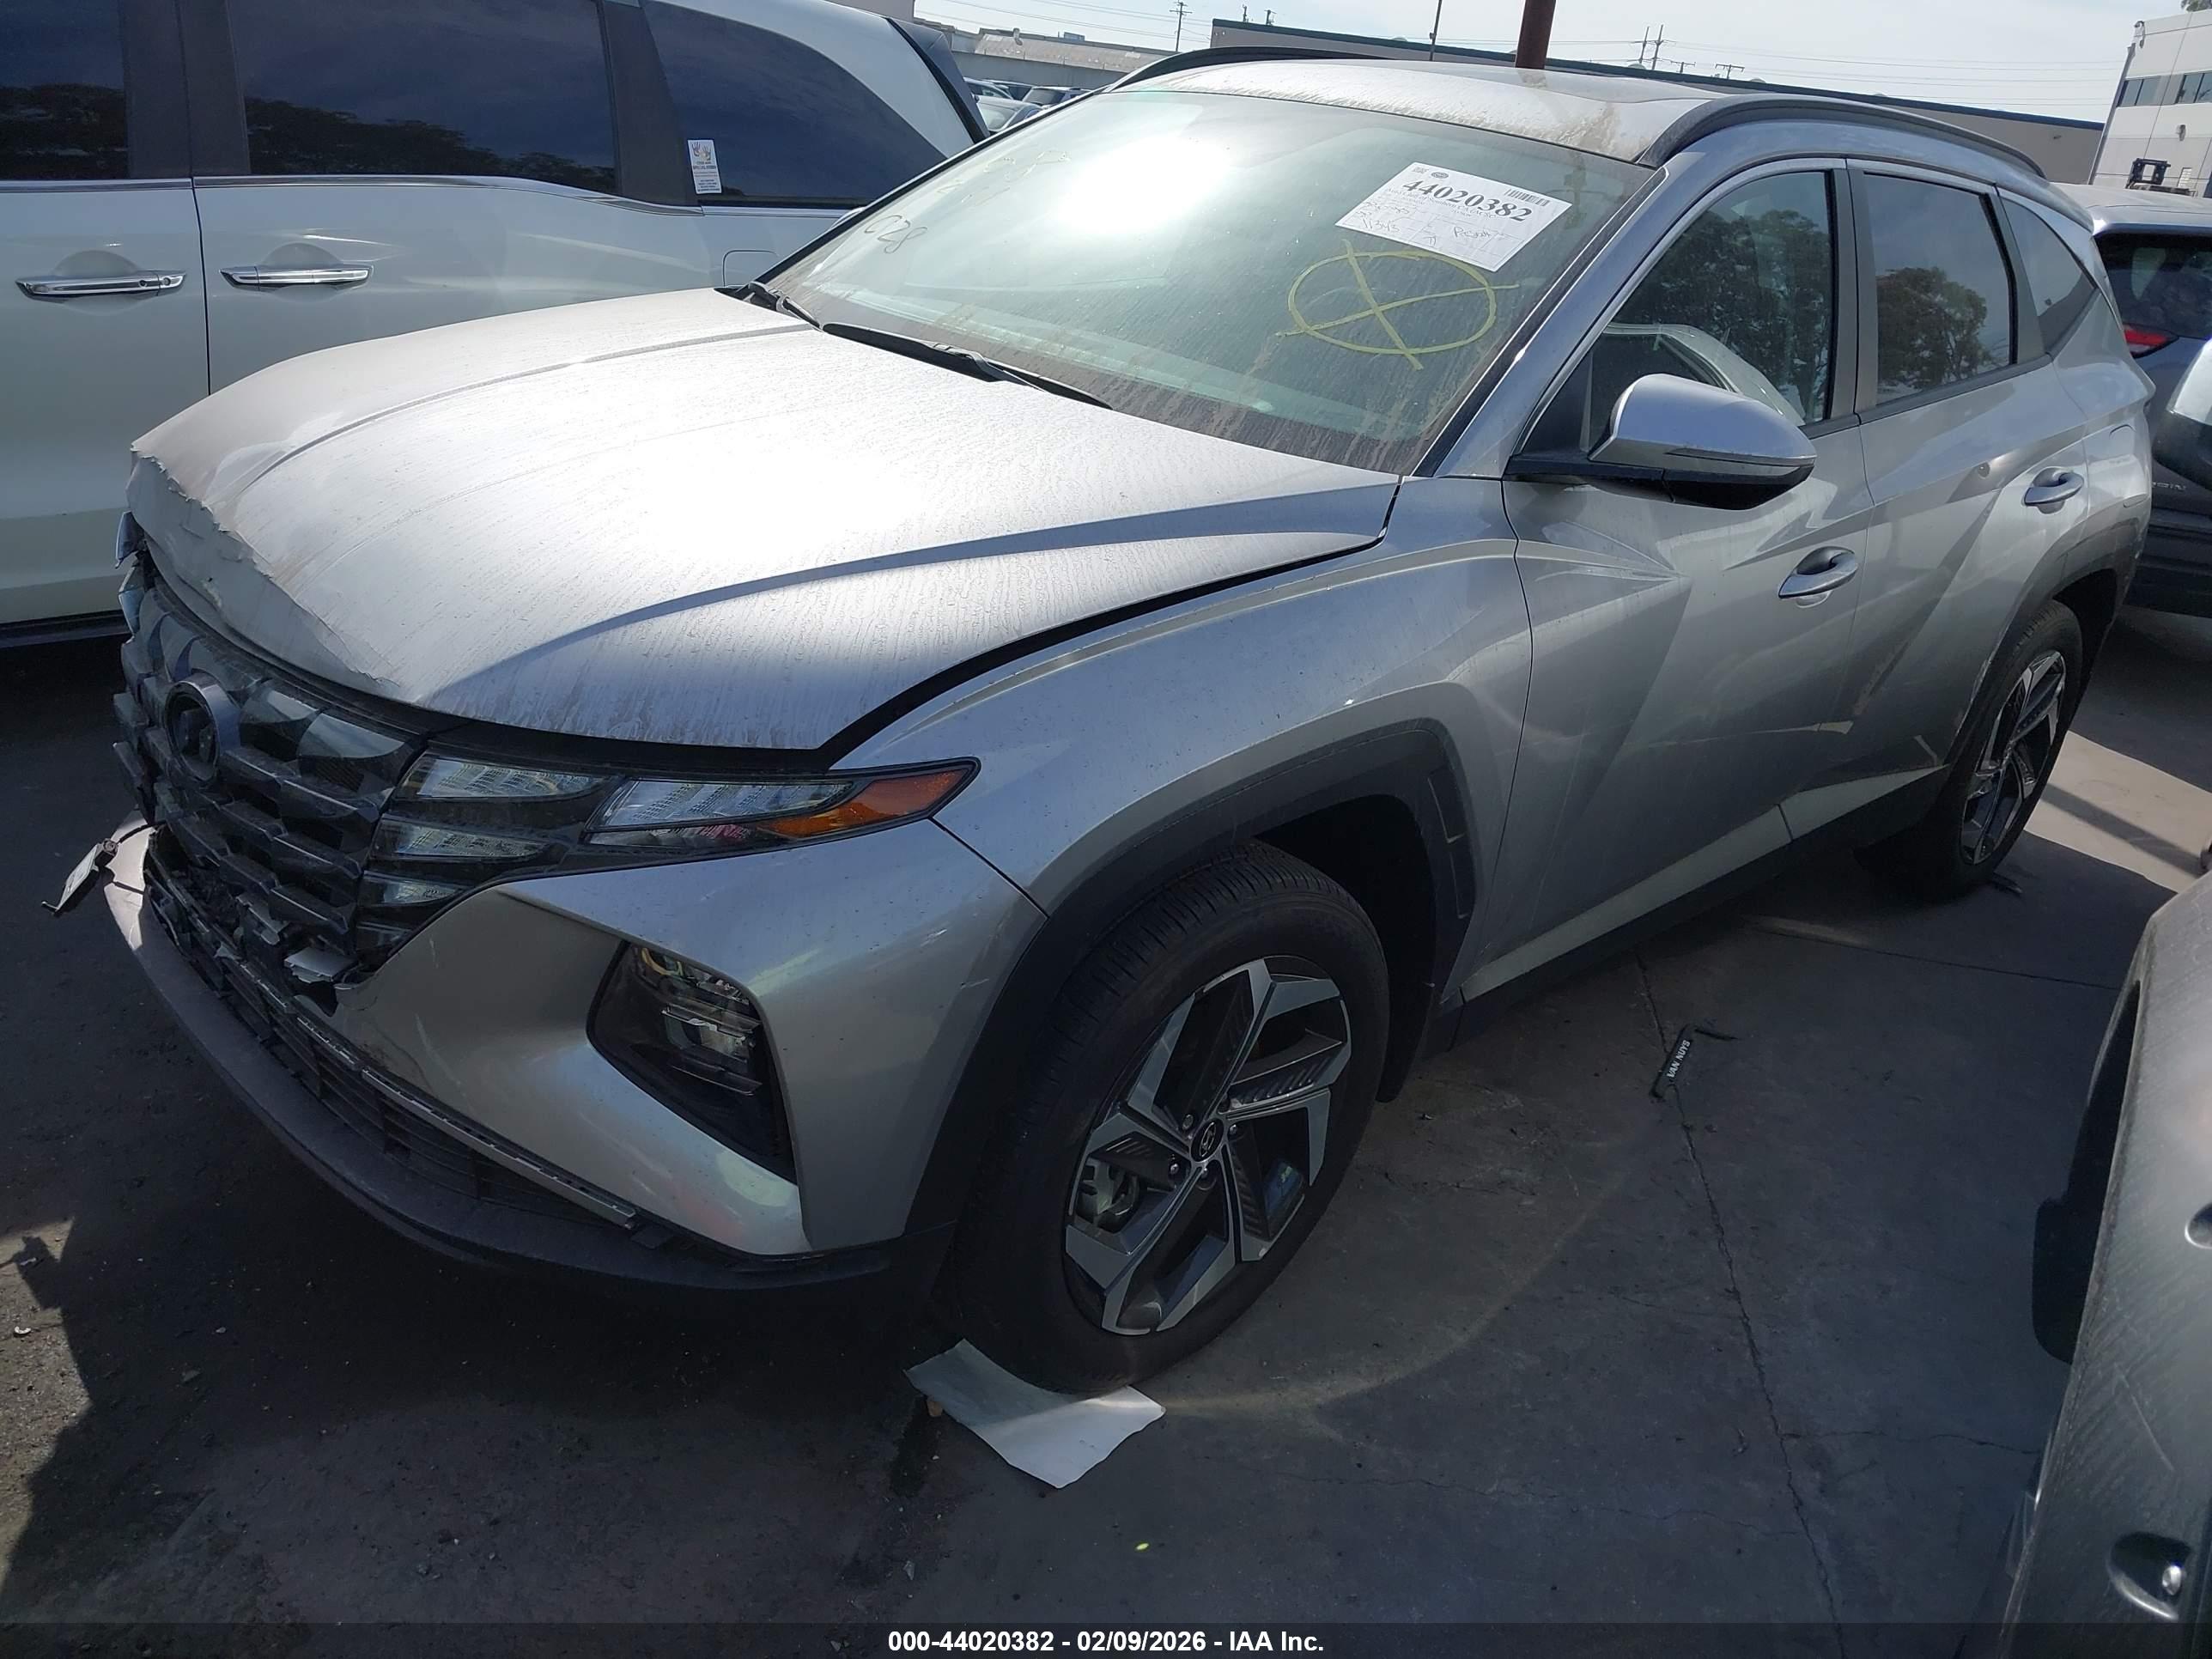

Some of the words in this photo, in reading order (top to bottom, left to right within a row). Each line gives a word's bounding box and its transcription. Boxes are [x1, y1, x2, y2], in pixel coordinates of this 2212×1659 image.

[1403, 180, 1532, 222] 44020382
[1667, 1060, 1680, 1078] VAN
[1675, 1040, 1691, 1060] NUYS
